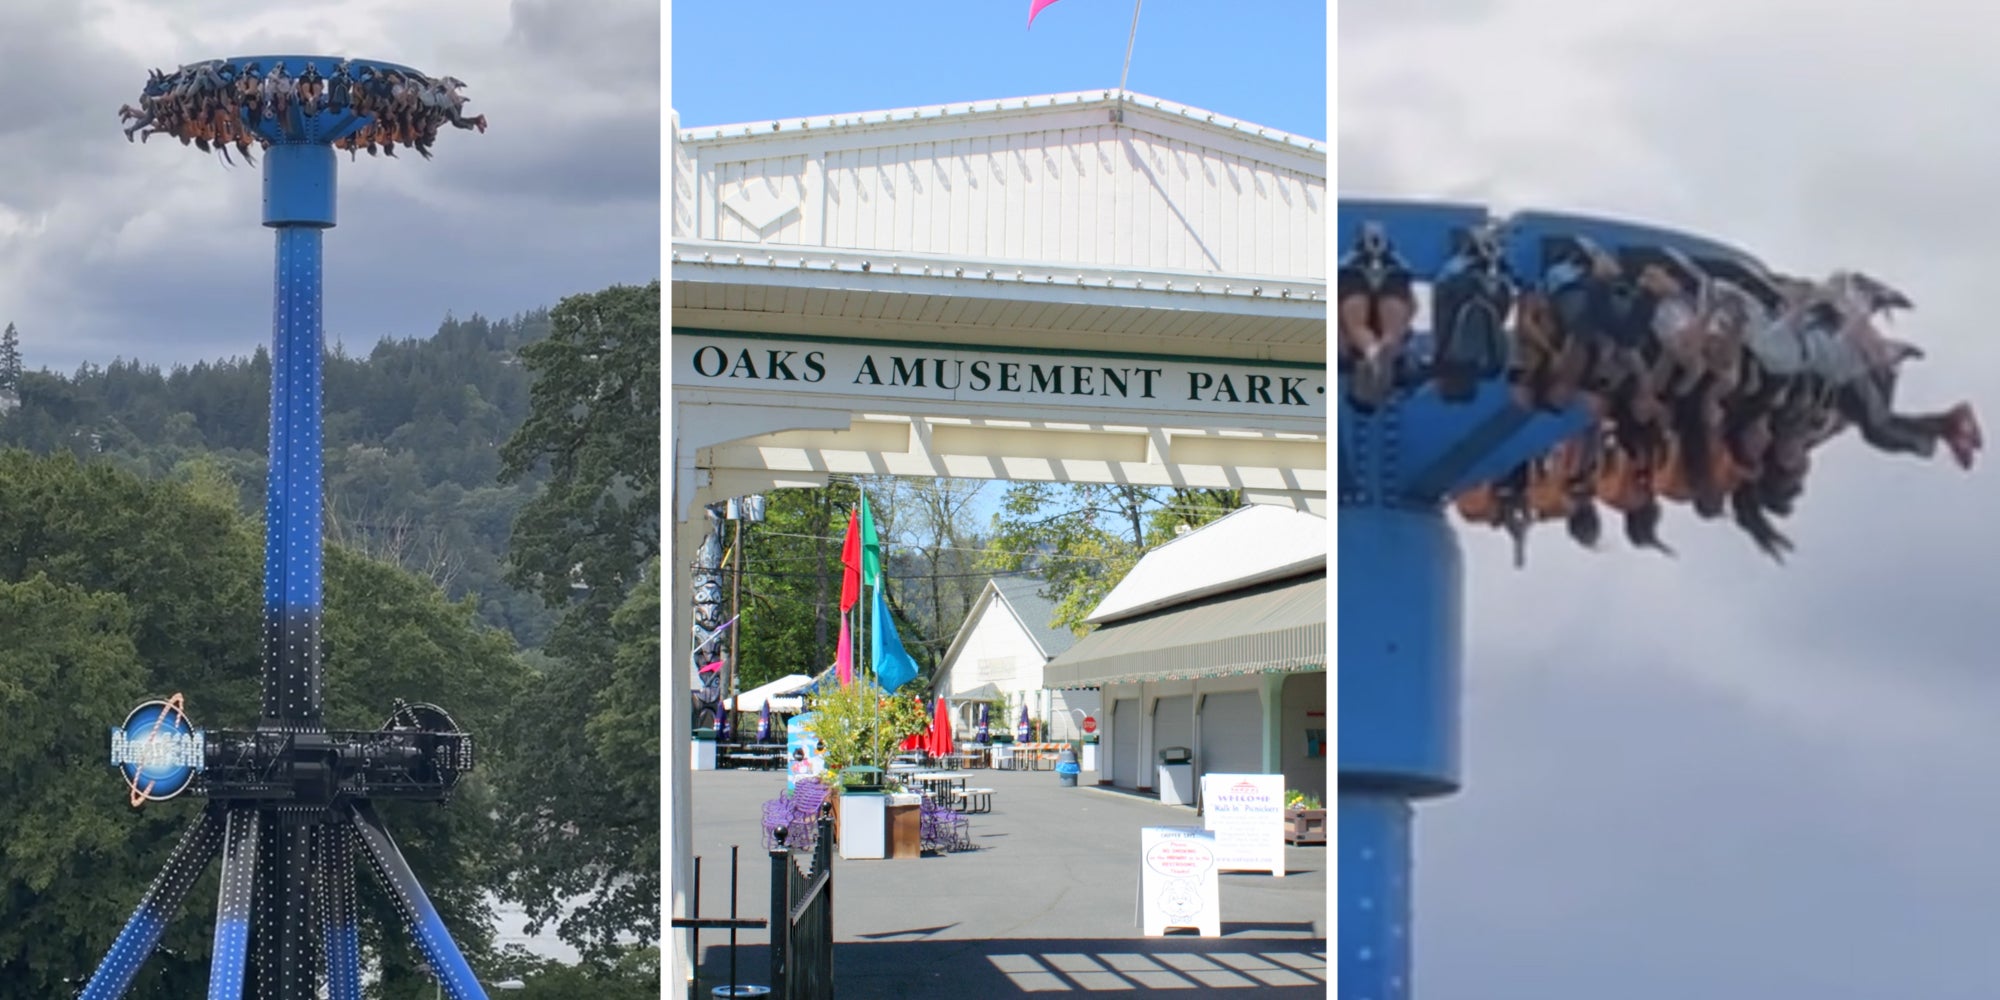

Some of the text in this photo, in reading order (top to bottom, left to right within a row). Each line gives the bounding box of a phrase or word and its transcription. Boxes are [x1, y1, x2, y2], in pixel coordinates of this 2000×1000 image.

[692, 345, 1311, 406] OAKS AMUSEMENT PARK
[1214, 804, 1230, 812] Walk
